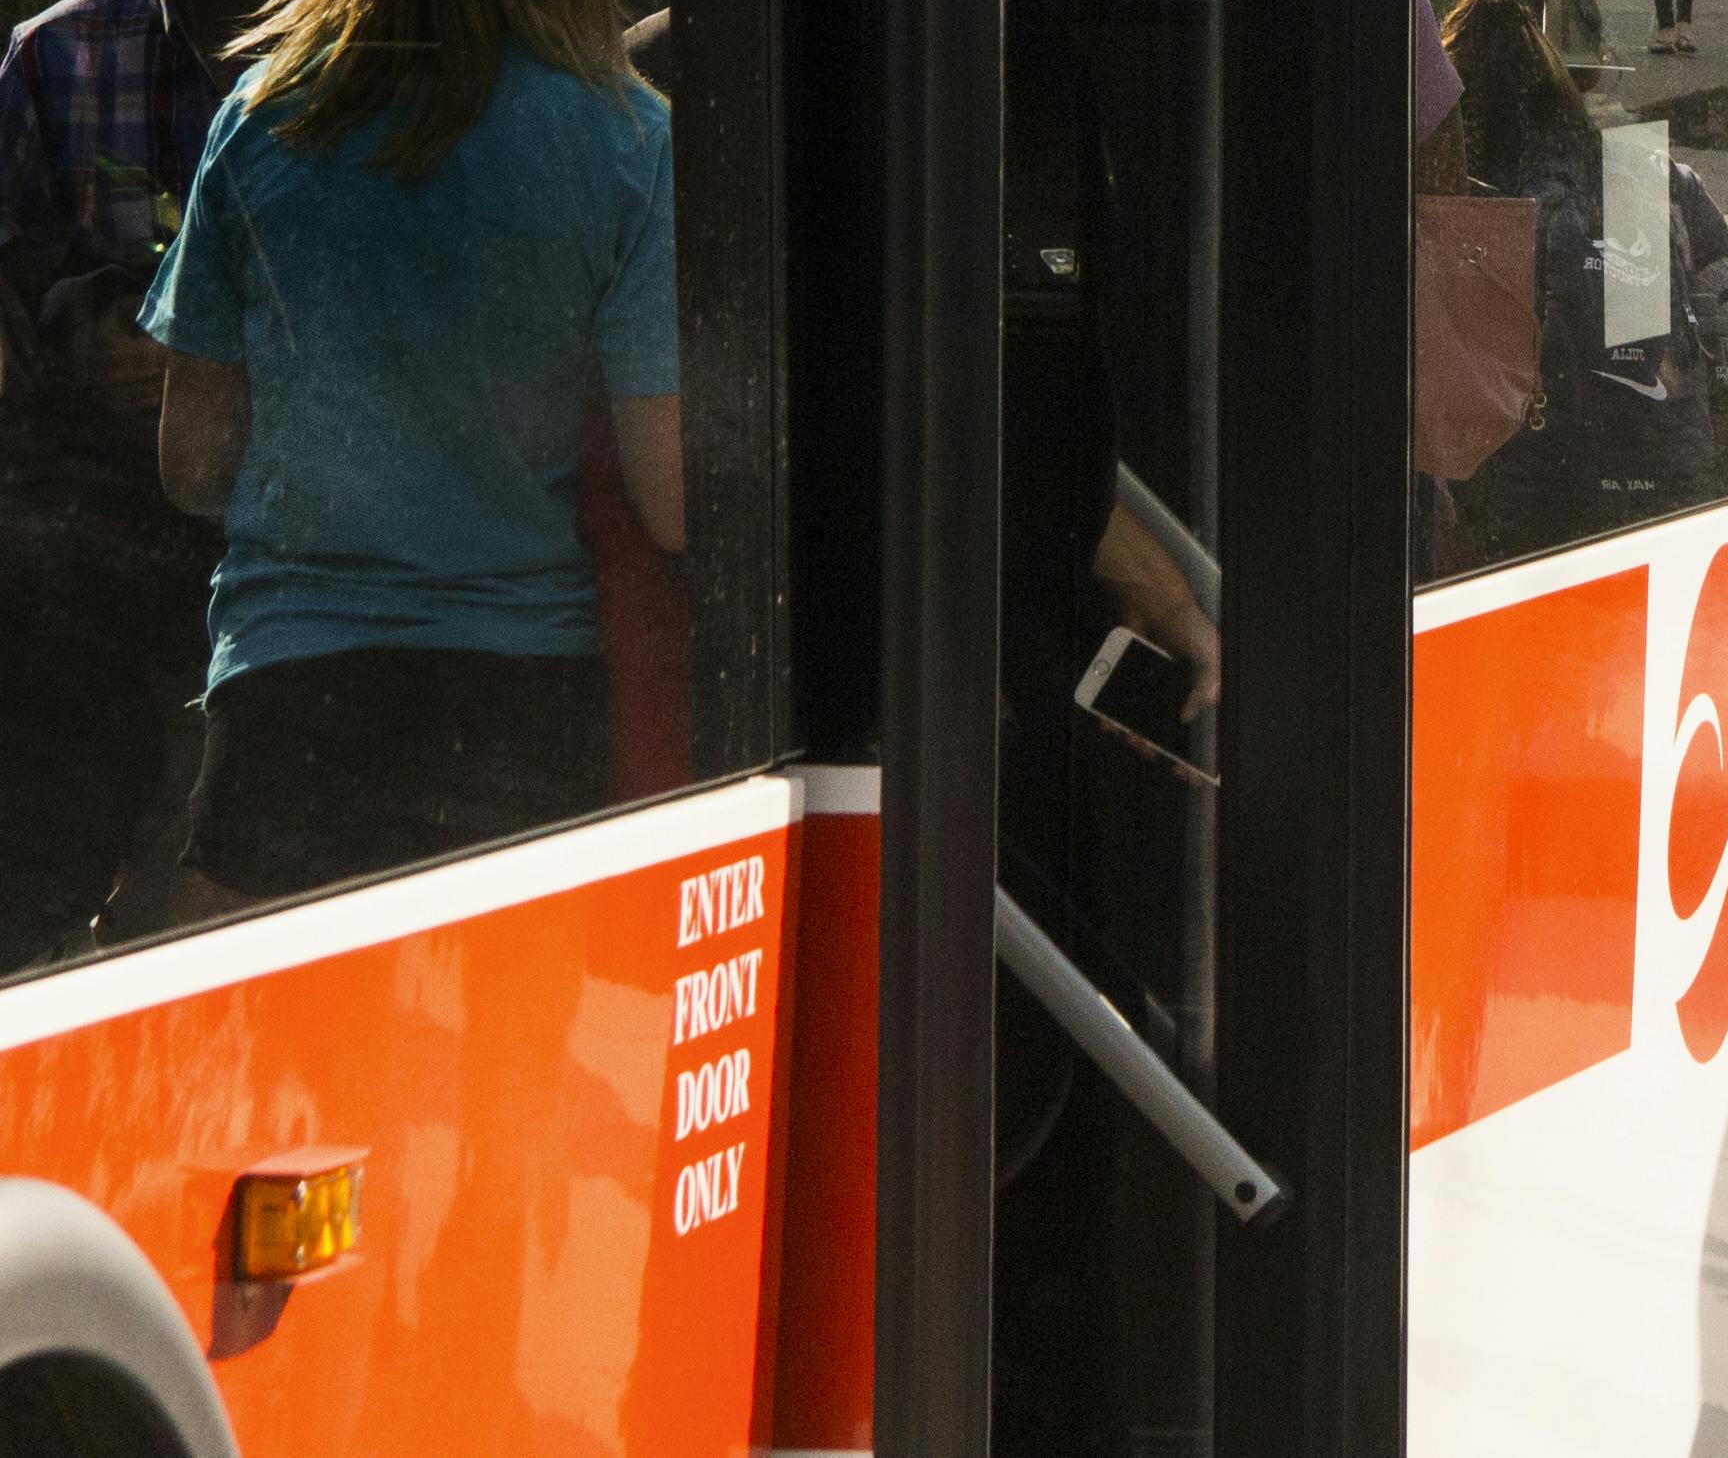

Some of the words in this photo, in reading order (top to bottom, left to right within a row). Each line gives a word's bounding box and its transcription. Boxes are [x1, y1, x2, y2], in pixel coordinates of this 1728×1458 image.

[677, 854, 765, 950] ENTER
[672, 948, 763, 1047] FRONT
[674, 1047, 750, 1143] DOOR
[673, 1142, 746, 1237] ONLY
